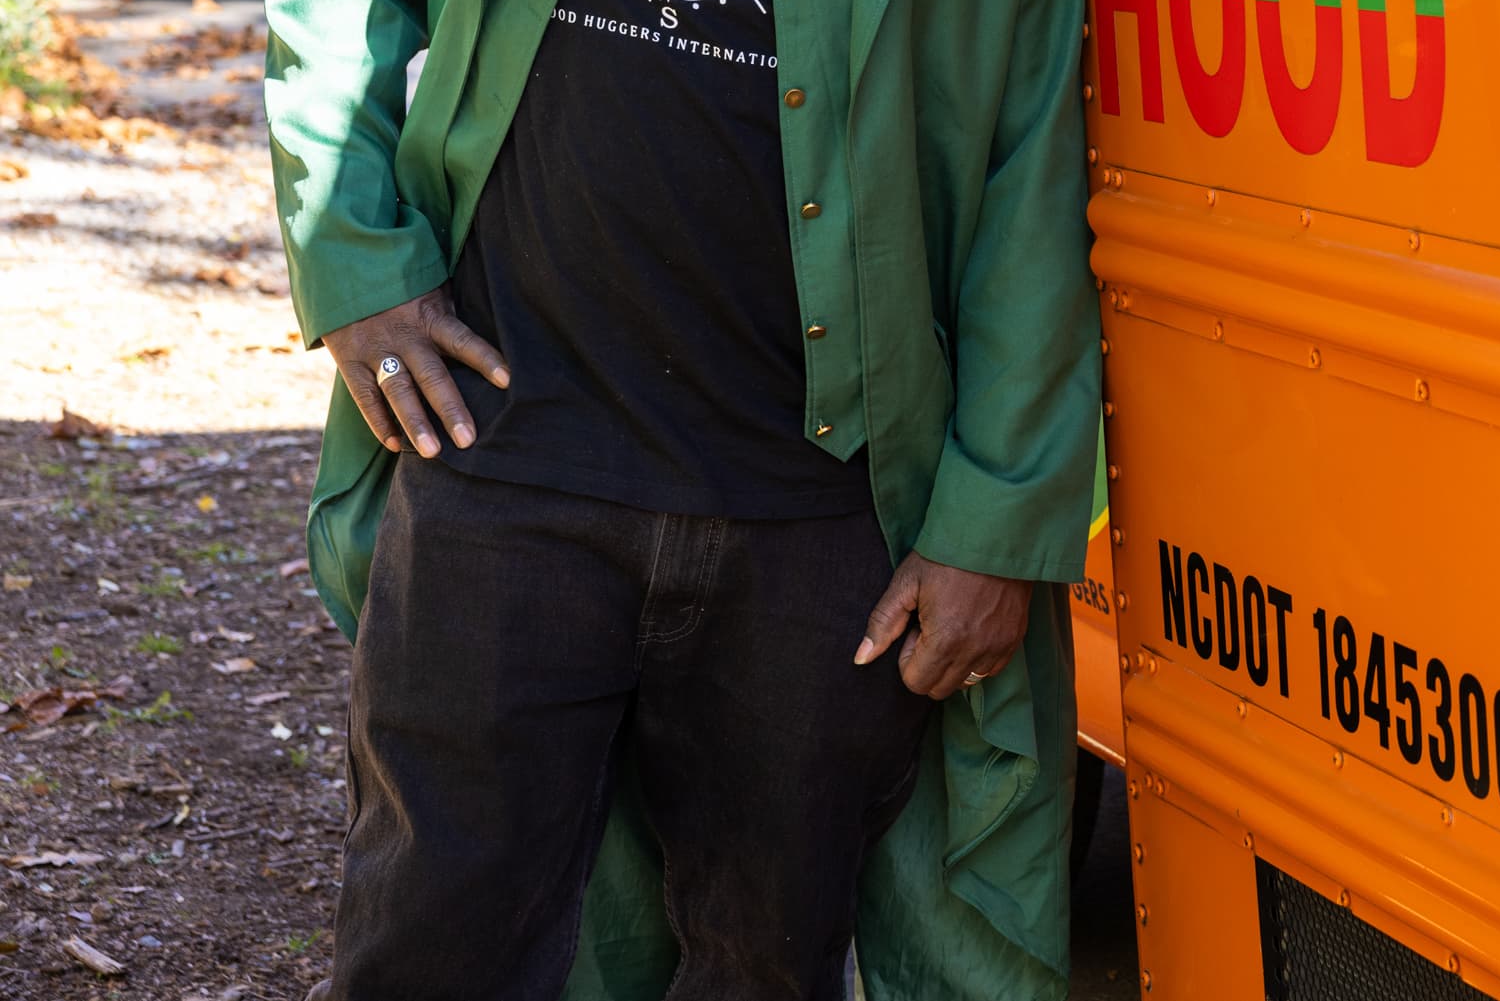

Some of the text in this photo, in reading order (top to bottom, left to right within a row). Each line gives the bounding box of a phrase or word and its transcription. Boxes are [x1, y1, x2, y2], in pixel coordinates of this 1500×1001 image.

[584, 14, 661, 43] HUGGERS
[668, 36, 778, 69] INTERNATIO
[659, 6, 679, 29] S
[1158, 539, 1293, 698] NCDOT
